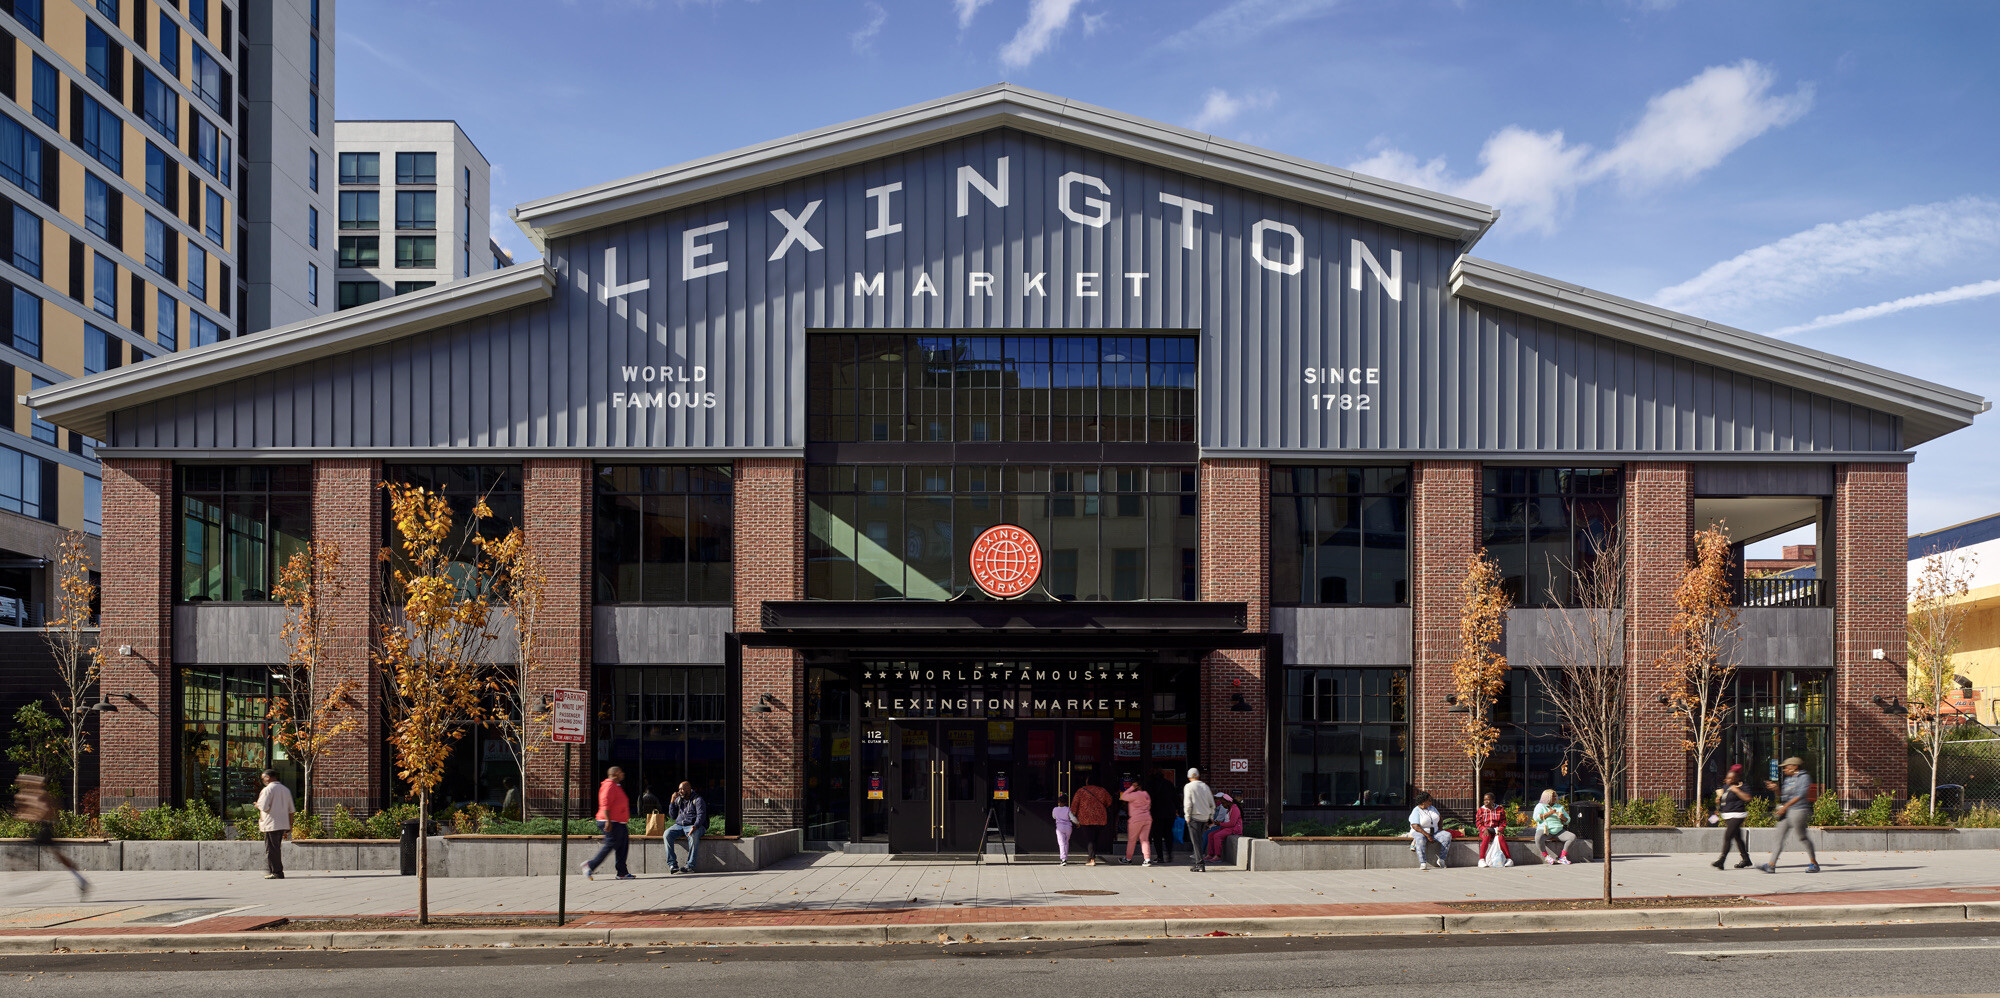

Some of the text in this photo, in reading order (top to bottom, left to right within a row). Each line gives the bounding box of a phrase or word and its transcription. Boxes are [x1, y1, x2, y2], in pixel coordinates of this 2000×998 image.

[602, 154, 1403, 302] LEXINGTON
[854, 271, 1150, 297] MARKET
[621, 366, 707, 382] WORLD
[1304, 368, 1380, 384] SINCE
[612, 392, 717, 408] FAMOUS
[1311, 394, 1372, 410] 1782
[975, 529, 1037, 563] LEXINGTON
[978, 570, 1033, 592] MARKET
[909, 670, 1093, 681] WORLD FAMOUS
[556, 692, 585, 702] NO PARKING
[878, 699, 1125, 710] LEXINGTON MARKET
[867, 730, 882, 739] 112
[1119, 731, 1133, 740] 112
[1231, 761, 1247, 769] FDC
